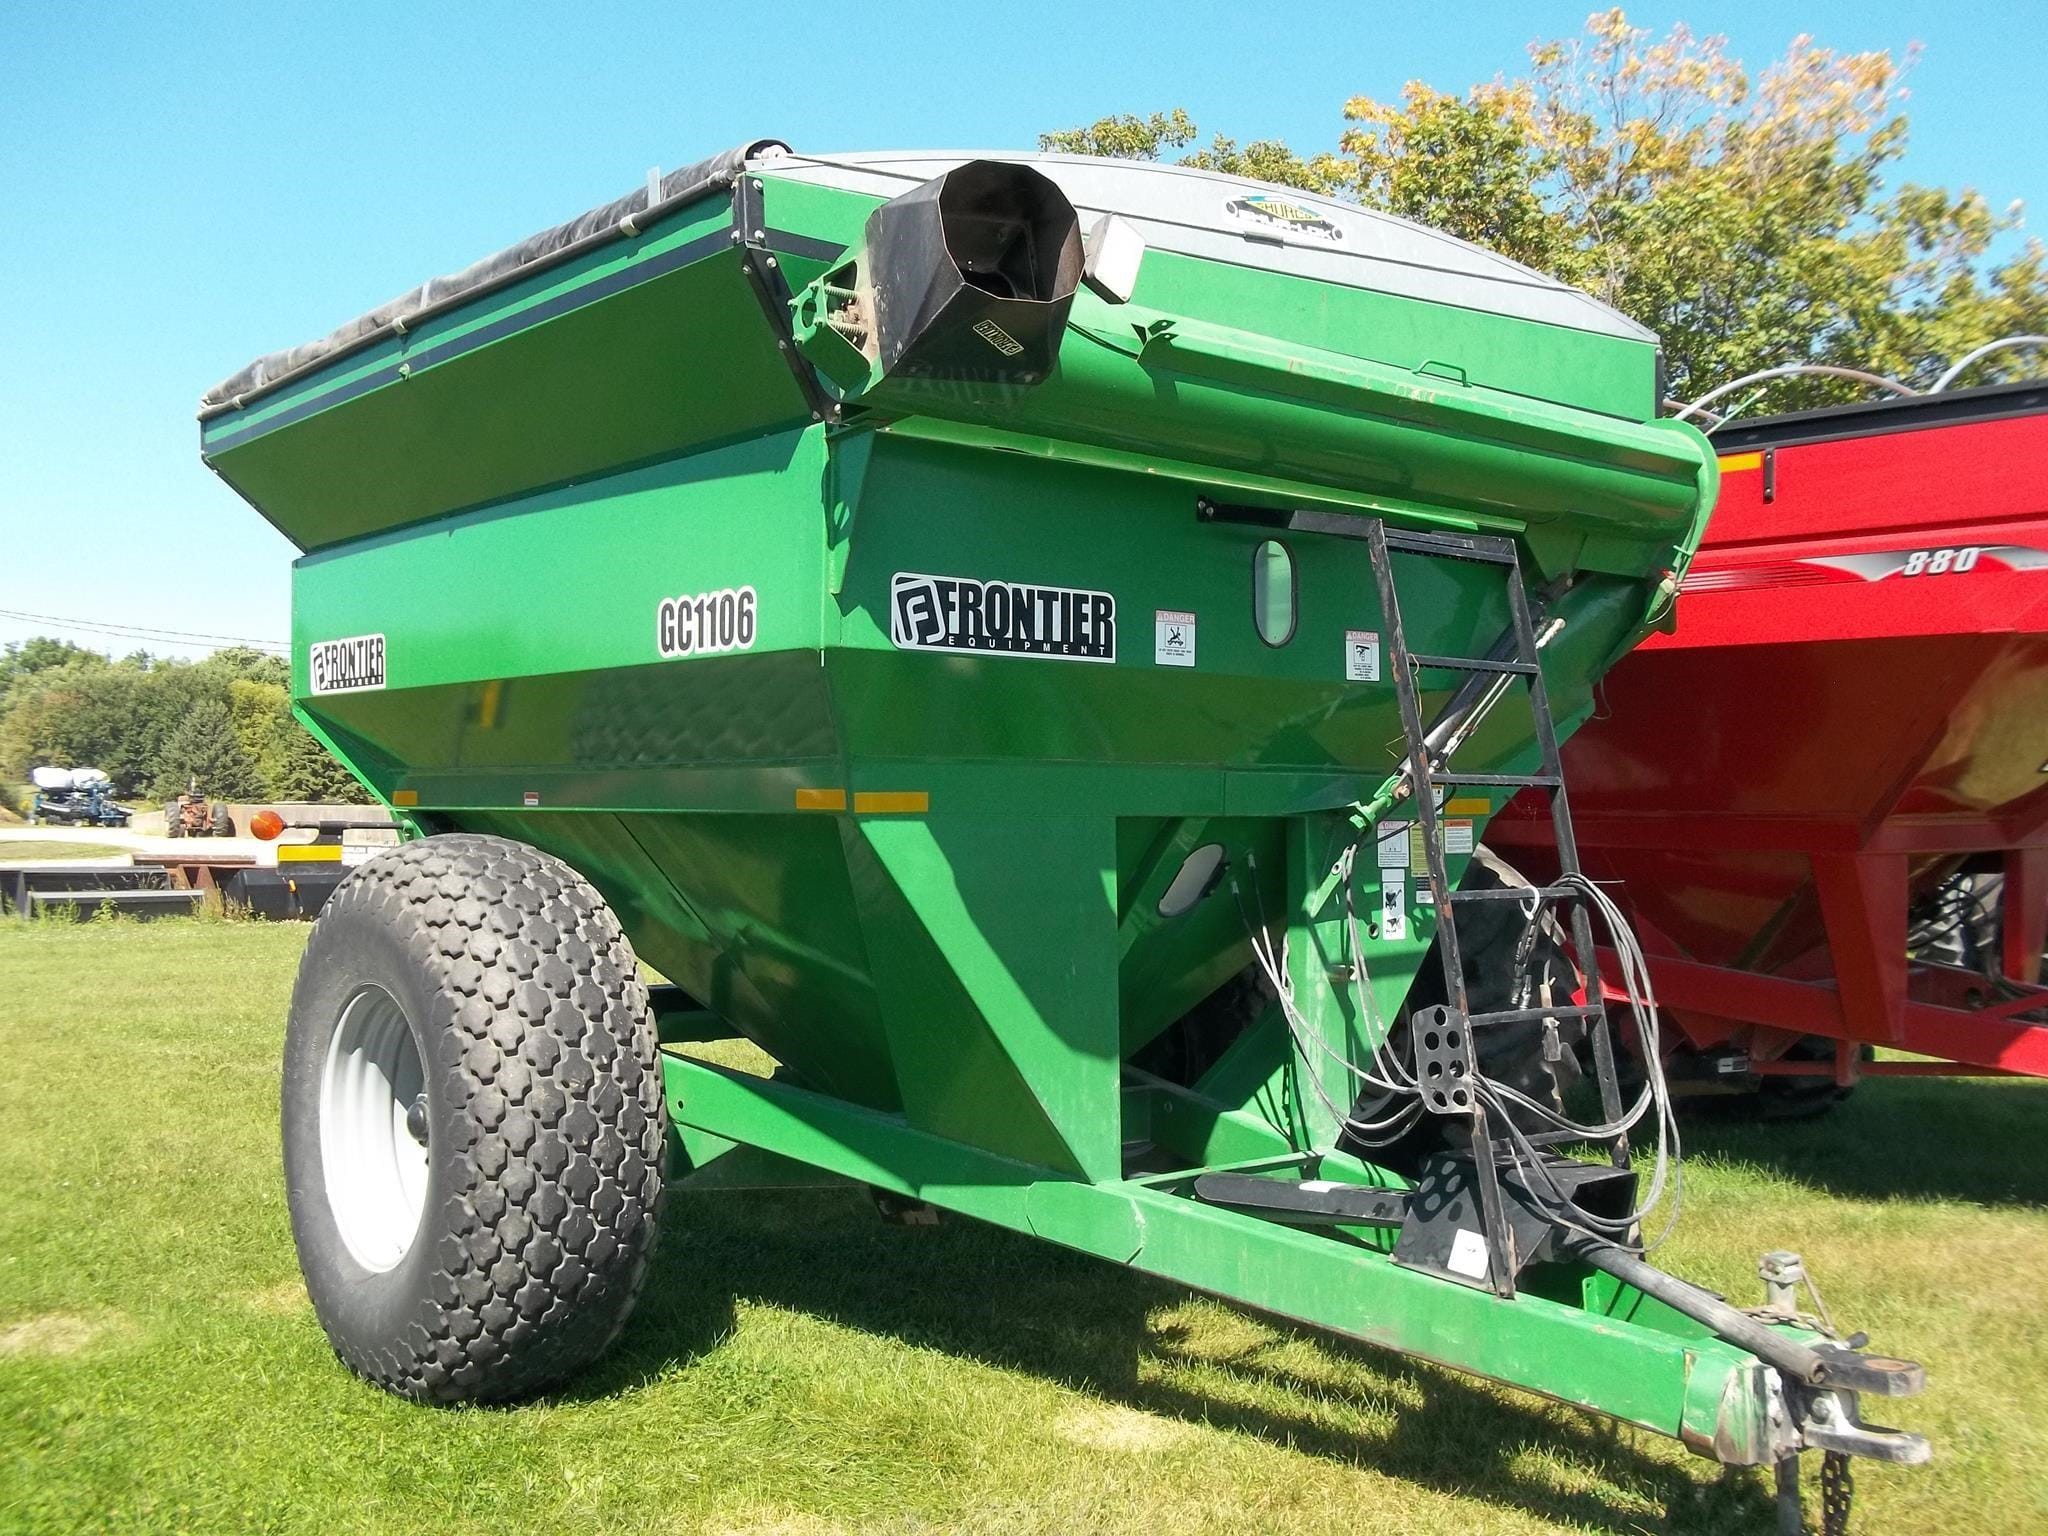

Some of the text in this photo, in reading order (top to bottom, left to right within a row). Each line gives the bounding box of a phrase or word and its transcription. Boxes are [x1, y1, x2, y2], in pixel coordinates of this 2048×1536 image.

[1903, 547, 1980, 576] 880
[661, 591, 754, 653] GC1106
[936, 581, 1113, 645] FRONTIER
[1163, 612, 1195, 624] DANGER
[949, 635, 1105, 656] EQUIPMENT
[1352, 632, 1378, 642] DANGER
[324, 637, 384, 681] FRONTIER
